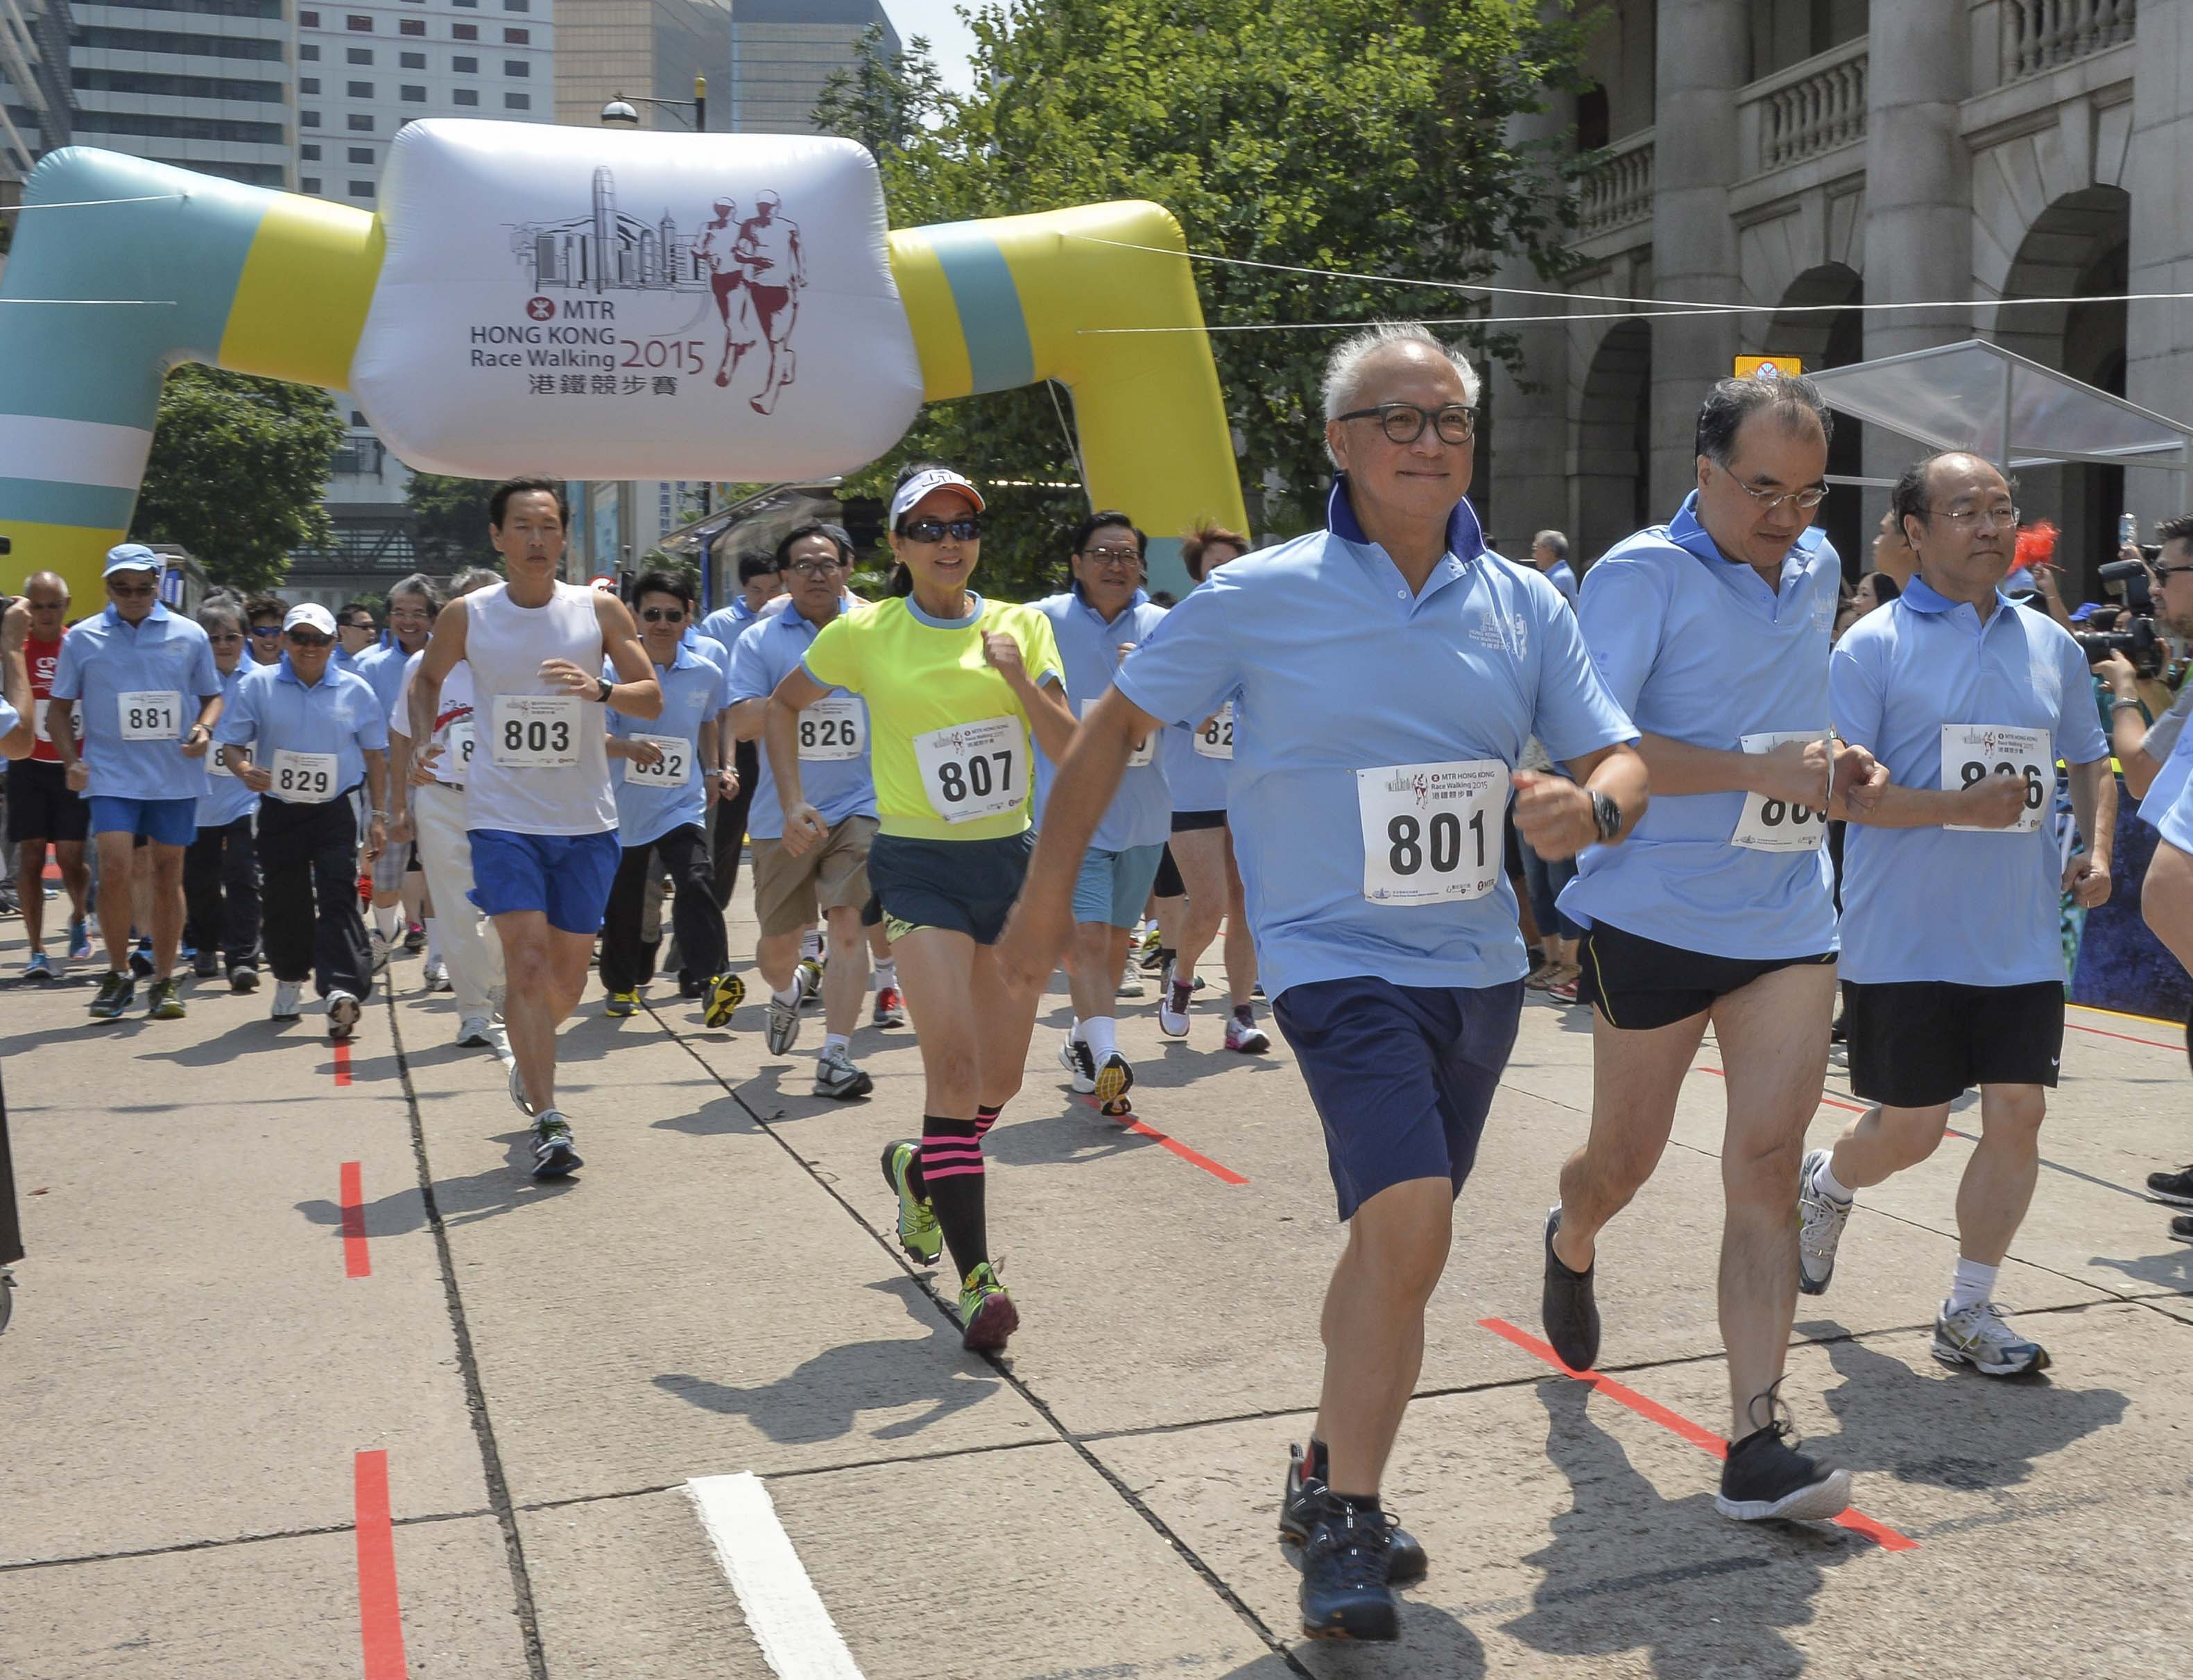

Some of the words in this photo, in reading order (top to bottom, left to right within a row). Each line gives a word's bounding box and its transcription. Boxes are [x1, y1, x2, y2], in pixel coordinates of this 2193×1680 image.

[564, 300, 614, 320] MTR
[472, 326, 540, 344] HONG
[549, 327, 614, 345] KONG
[472, 349, 521, 367] Race
[527, 349, 614, 371] Walking
[621, 340, 705, 374] 2015
[529, 374, 678, 395] 港鐵競步賽
[130, 707, 171, 729] 881
[505, 720, 569, 752] 803
[800, 720, 855, 747] 826
[281, 768, 328, 793] 829
[938, 750, 1012, 802] 807
[1472, 781, 1488, 790] 2015
[1388, 809, 1485, 876] 801
[1484, 878, 1495, 888] MTR
